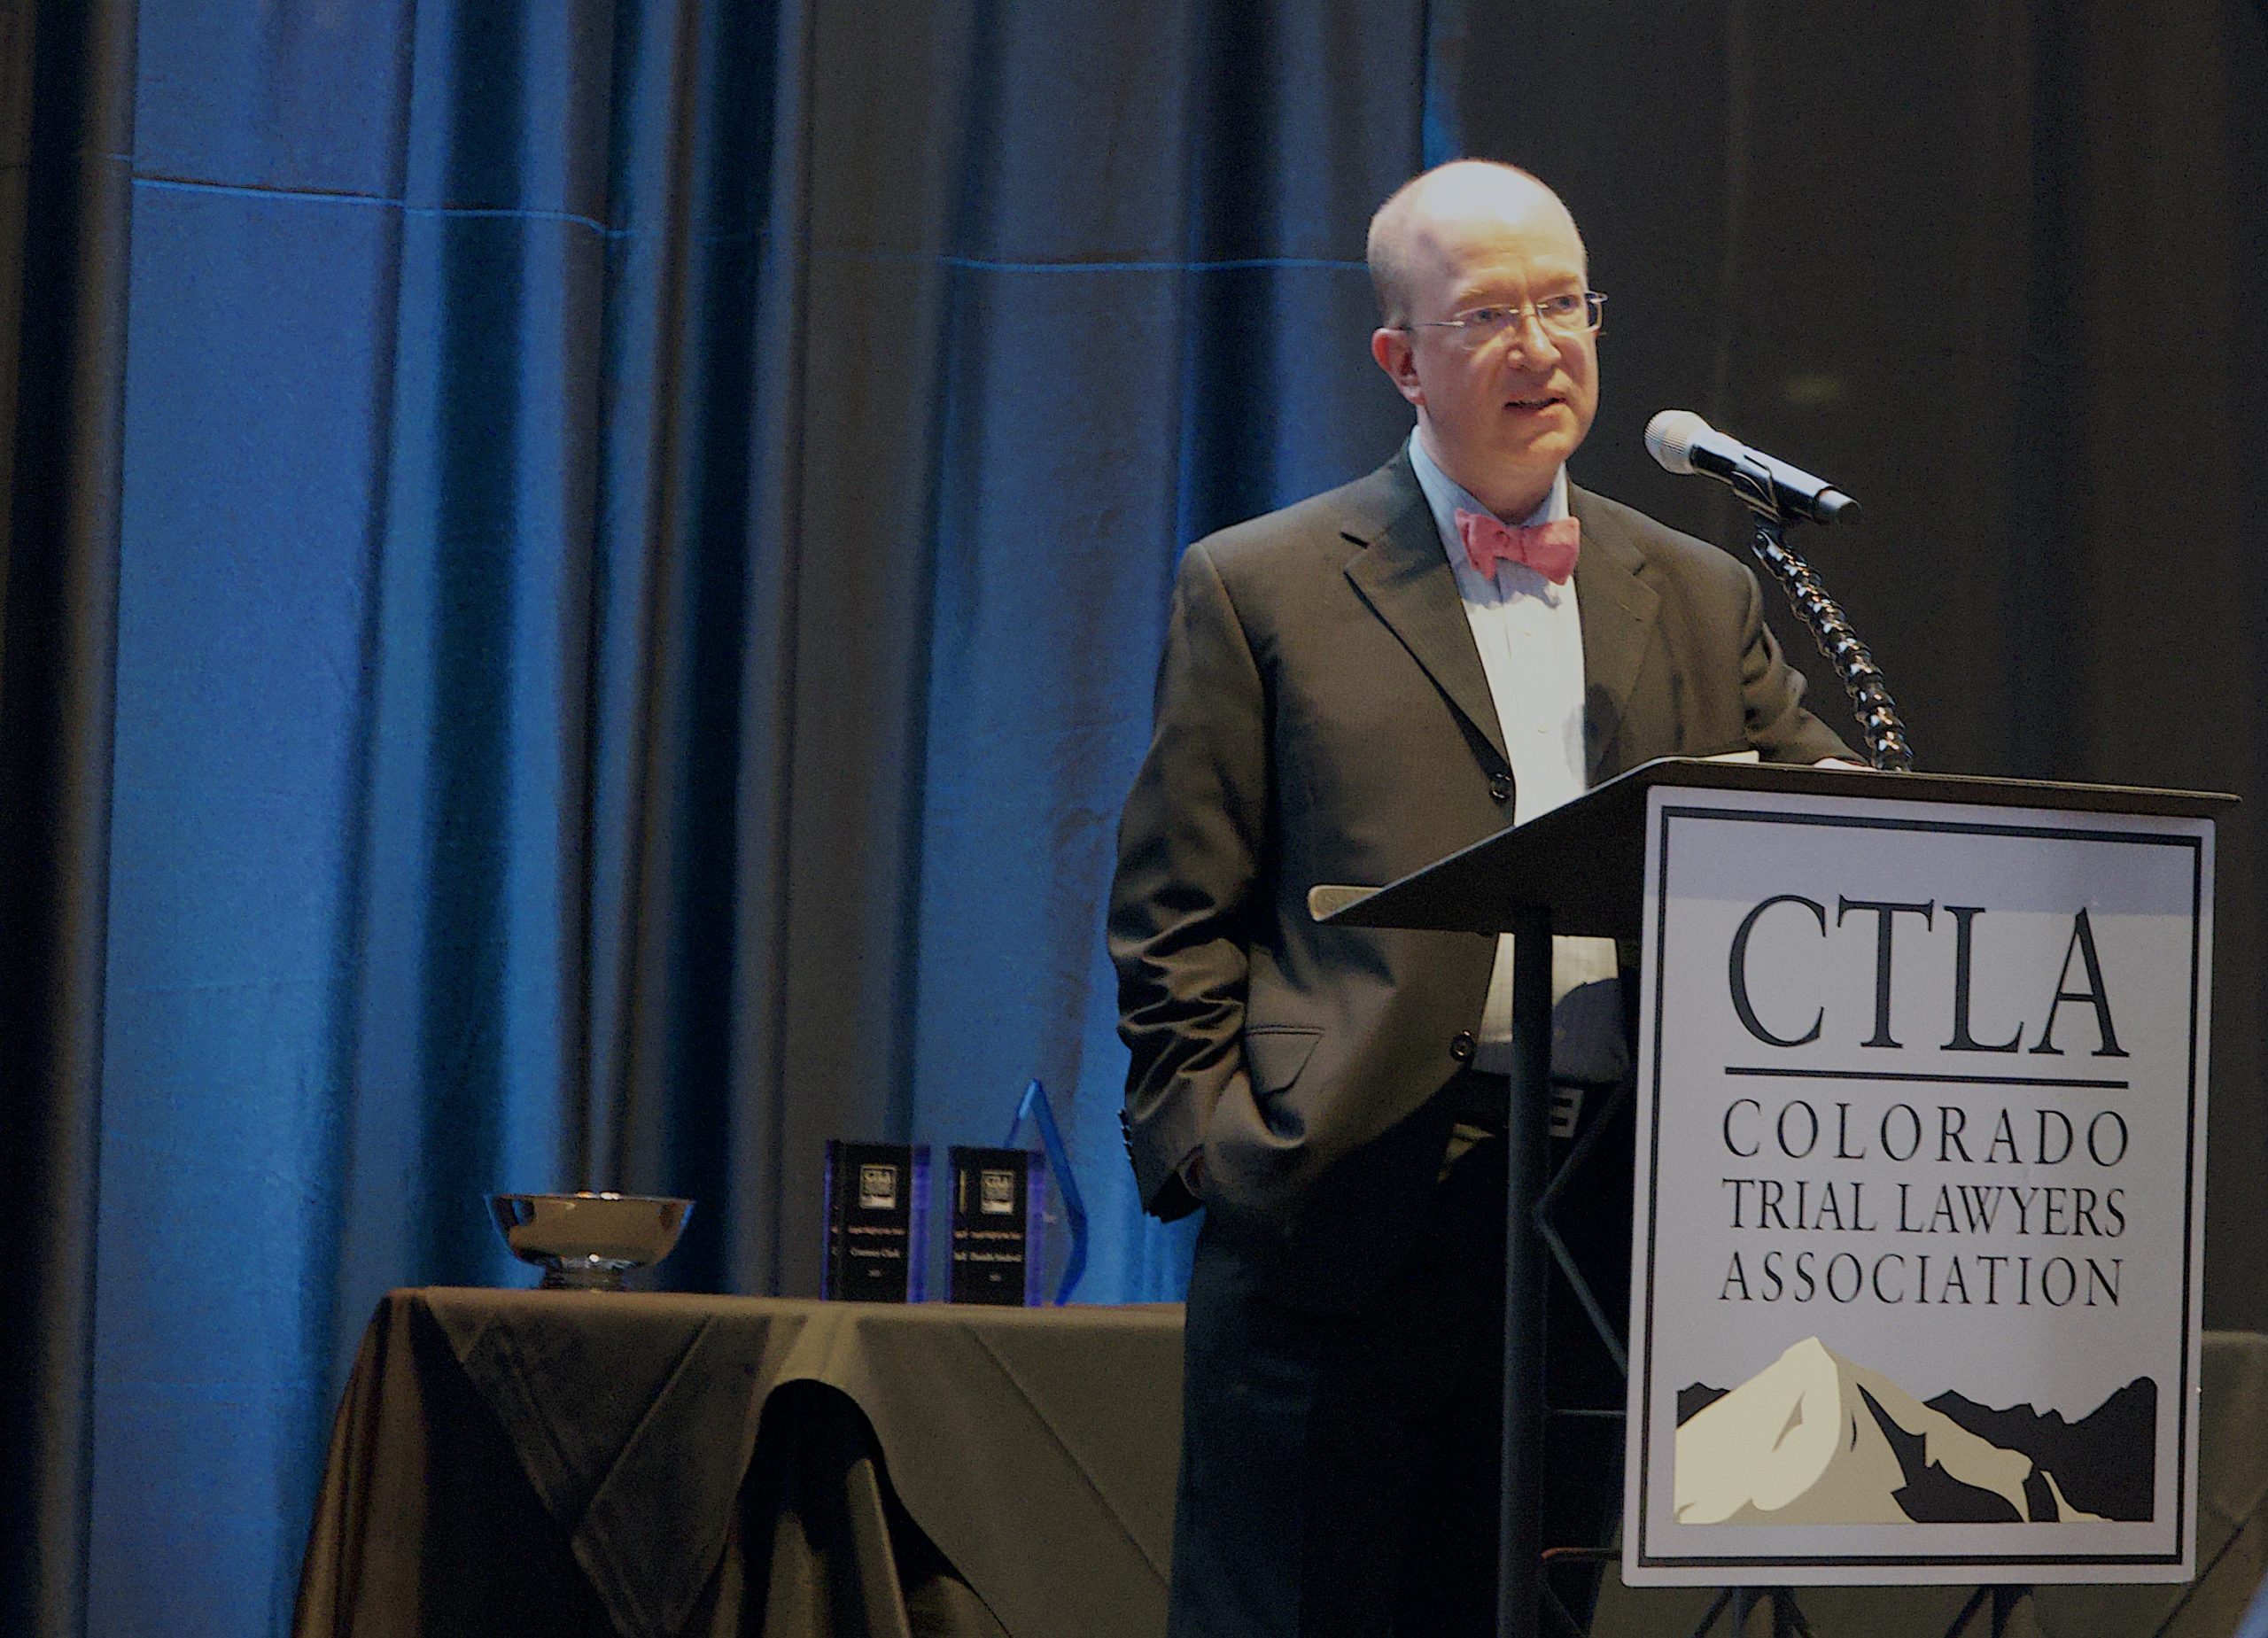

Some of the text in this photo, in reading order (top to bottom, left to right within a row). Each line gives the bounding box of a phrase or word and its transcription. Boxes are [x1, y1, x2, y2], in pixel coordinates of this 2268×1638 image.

[1728, 894, 2130, 1058] CTLA
[1722, 1098, 2129, 1168] COLORADO
[1721, 1177, 2127, 1238] TRIAL LAWYERS
[1717, 1250, 2124, 1308] ASSOCIATION
